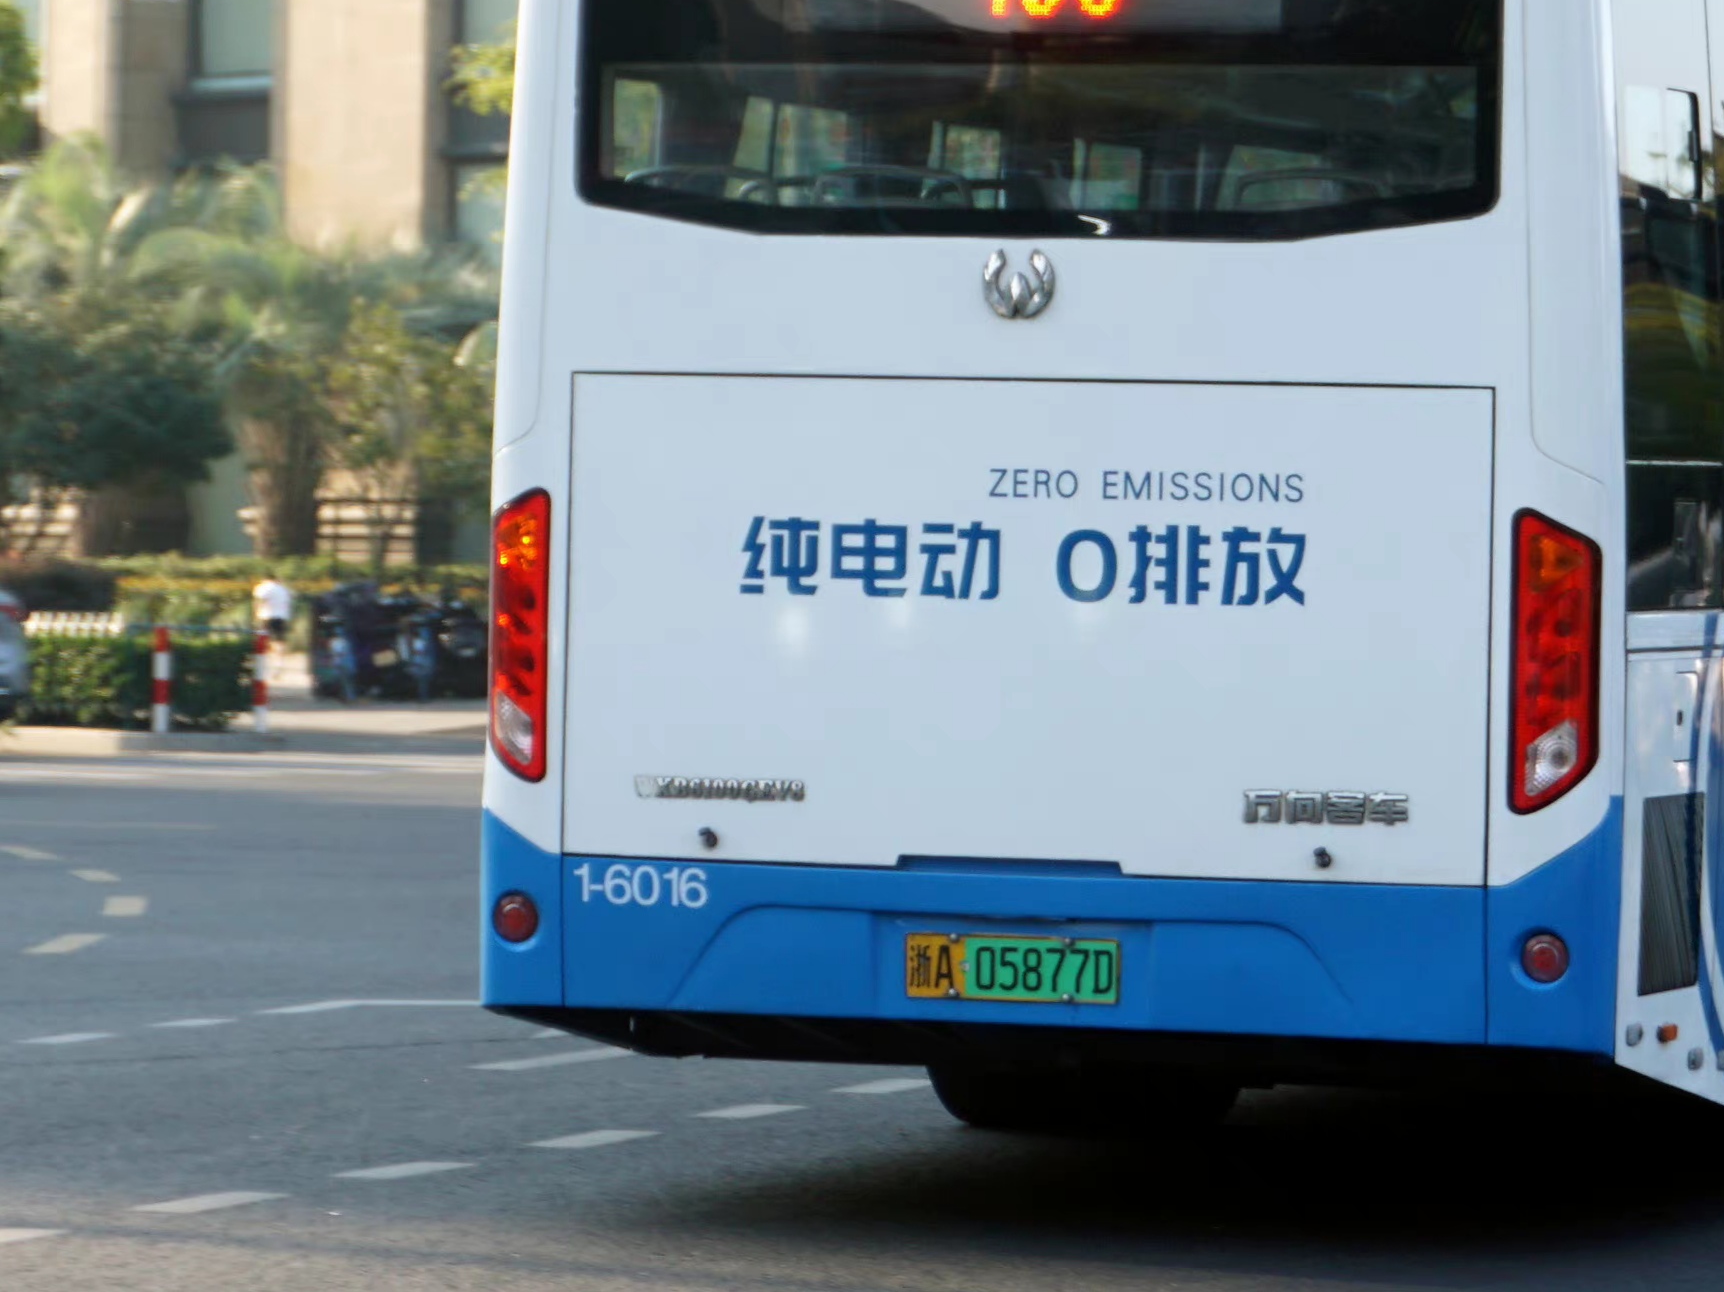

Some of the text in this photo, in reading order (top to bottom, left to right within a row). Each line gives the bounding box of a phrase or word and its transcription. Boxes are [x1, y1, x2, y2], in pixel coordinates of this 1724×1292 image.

[988, 468, 1305, 503] ZERO EMISSIONS
[739, 516, 1001, 600] 纯电动
[1243, 789, 1409, 825] 万向客车
[573, 863, 709, 908] 1-6016
